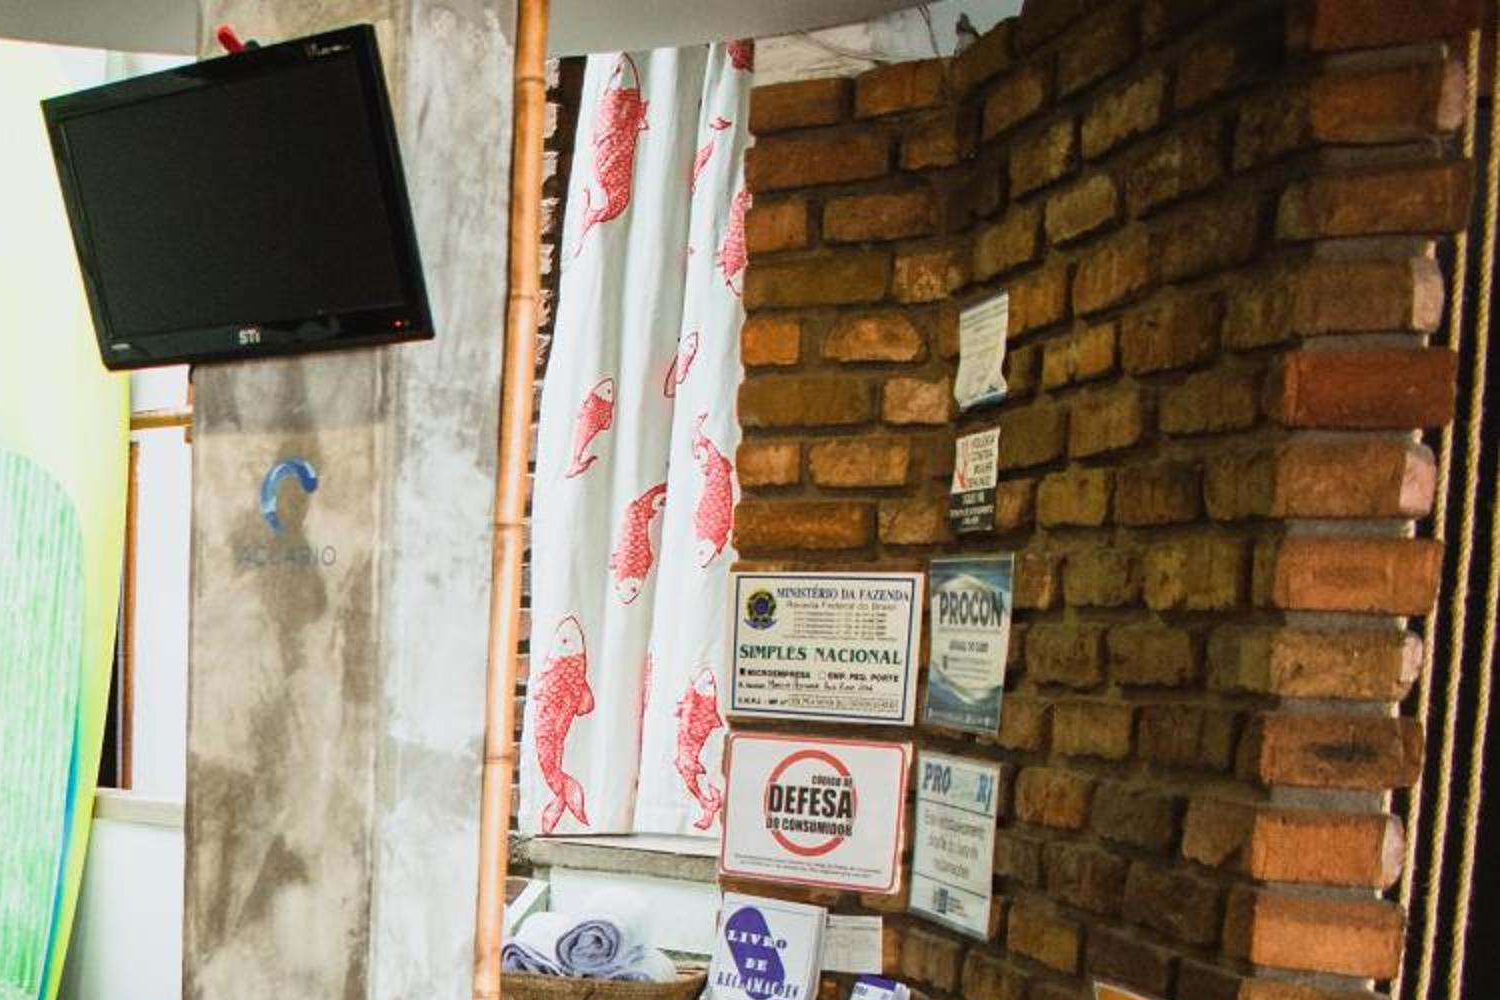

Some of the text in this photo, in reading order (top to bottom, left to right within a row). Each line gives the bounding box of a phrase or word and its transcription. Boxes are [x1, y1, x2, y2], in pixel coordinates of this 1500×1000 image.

[776, 584, 909, 602] MINISTÉRIO DA FAZENDA
[940, 591, 1004, 627] PROCON
[739, 645, 901, 665] SIMPLES NACIONAL
[770, 784, 852, 818] DEFESA
[782, 818, 852, 837] CONSUMIDOR
[727, 930, 787, 949] LIVRO
[745, 958, 768, 972] DE
